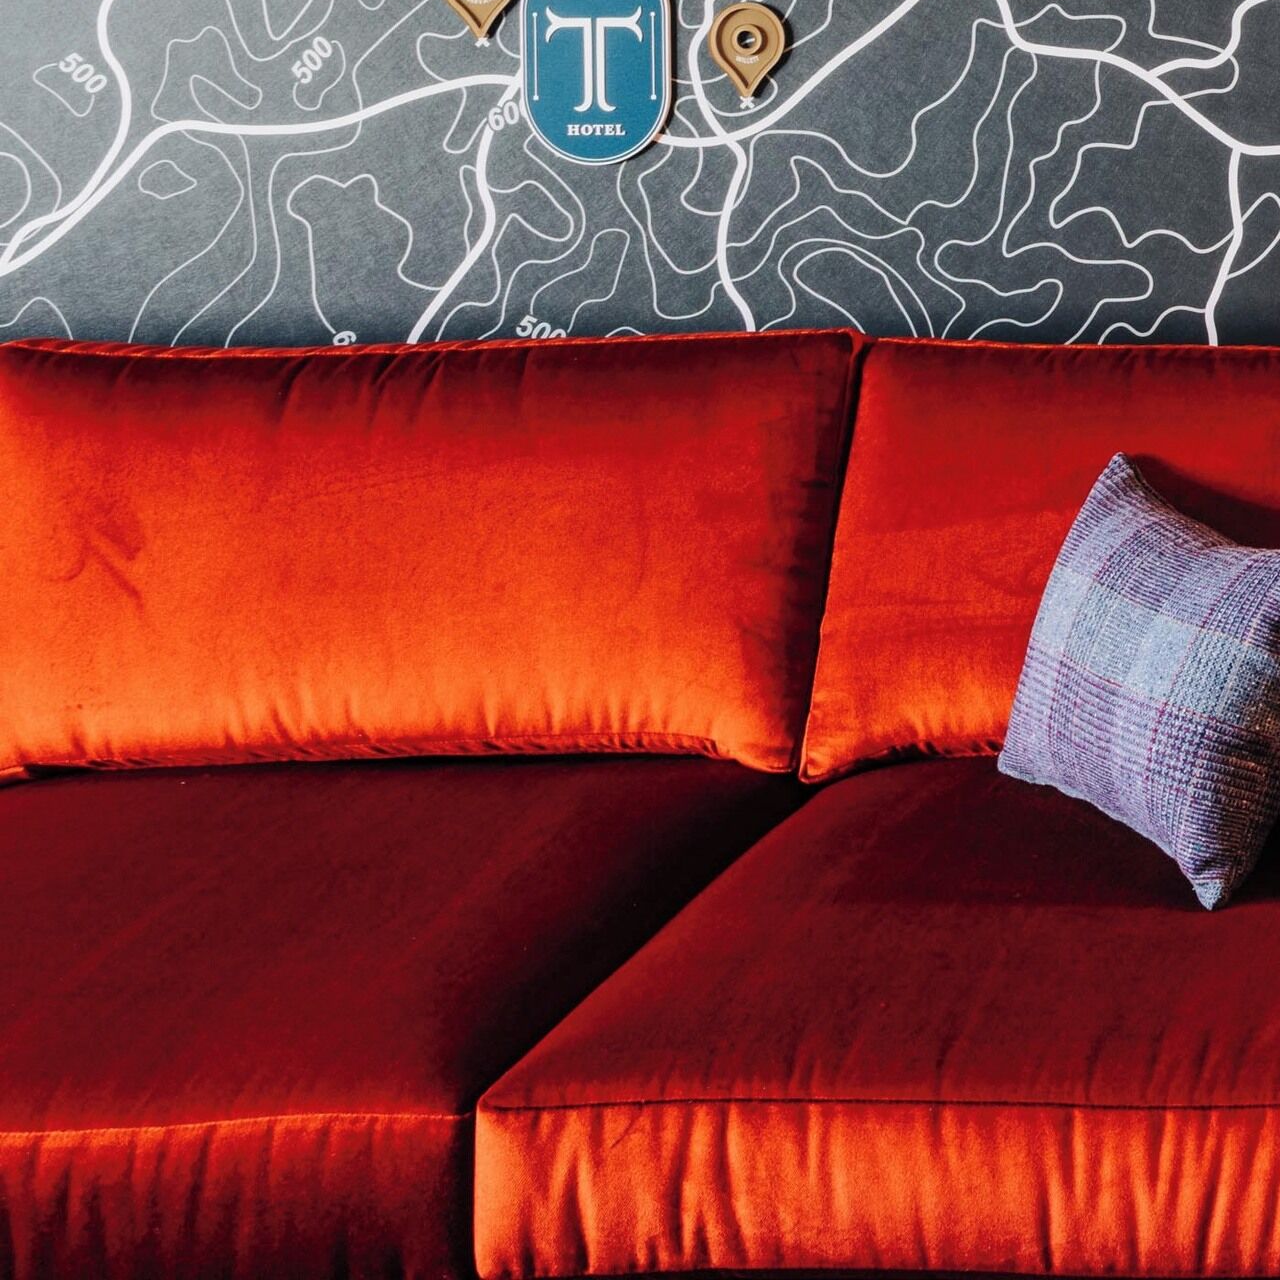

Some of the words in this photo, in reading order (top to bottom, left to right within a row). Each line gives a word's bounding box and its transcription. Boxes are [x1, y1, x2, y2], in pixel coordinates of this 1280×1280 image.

[58, 52, 108, 96] 500
[292, 36, 334, 85] 500
[566, 124, 626, 136] HOTEL
